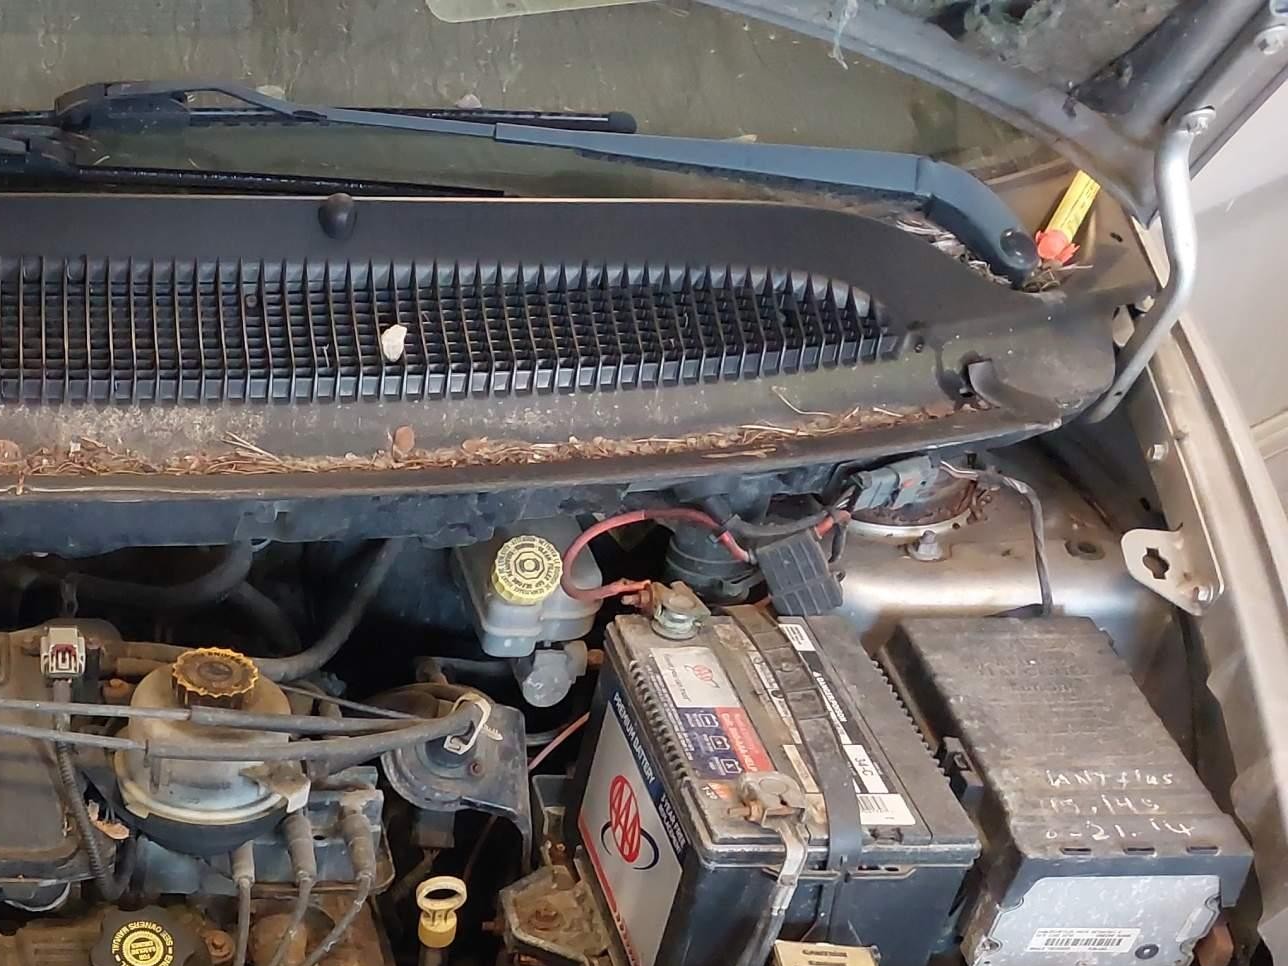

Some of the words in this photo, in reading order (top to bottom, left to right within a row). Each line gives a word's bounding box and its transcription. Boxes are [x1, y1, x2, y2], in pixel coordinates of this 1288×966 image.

[612, 692, 636, 741] PREMIUM
[632, 734, 656, 784] BATTERY
[128, 922, 162, 932] OWNERS
[160, 930, 174, 946] SEE
[112, 926, 130, 954] MANUAL
